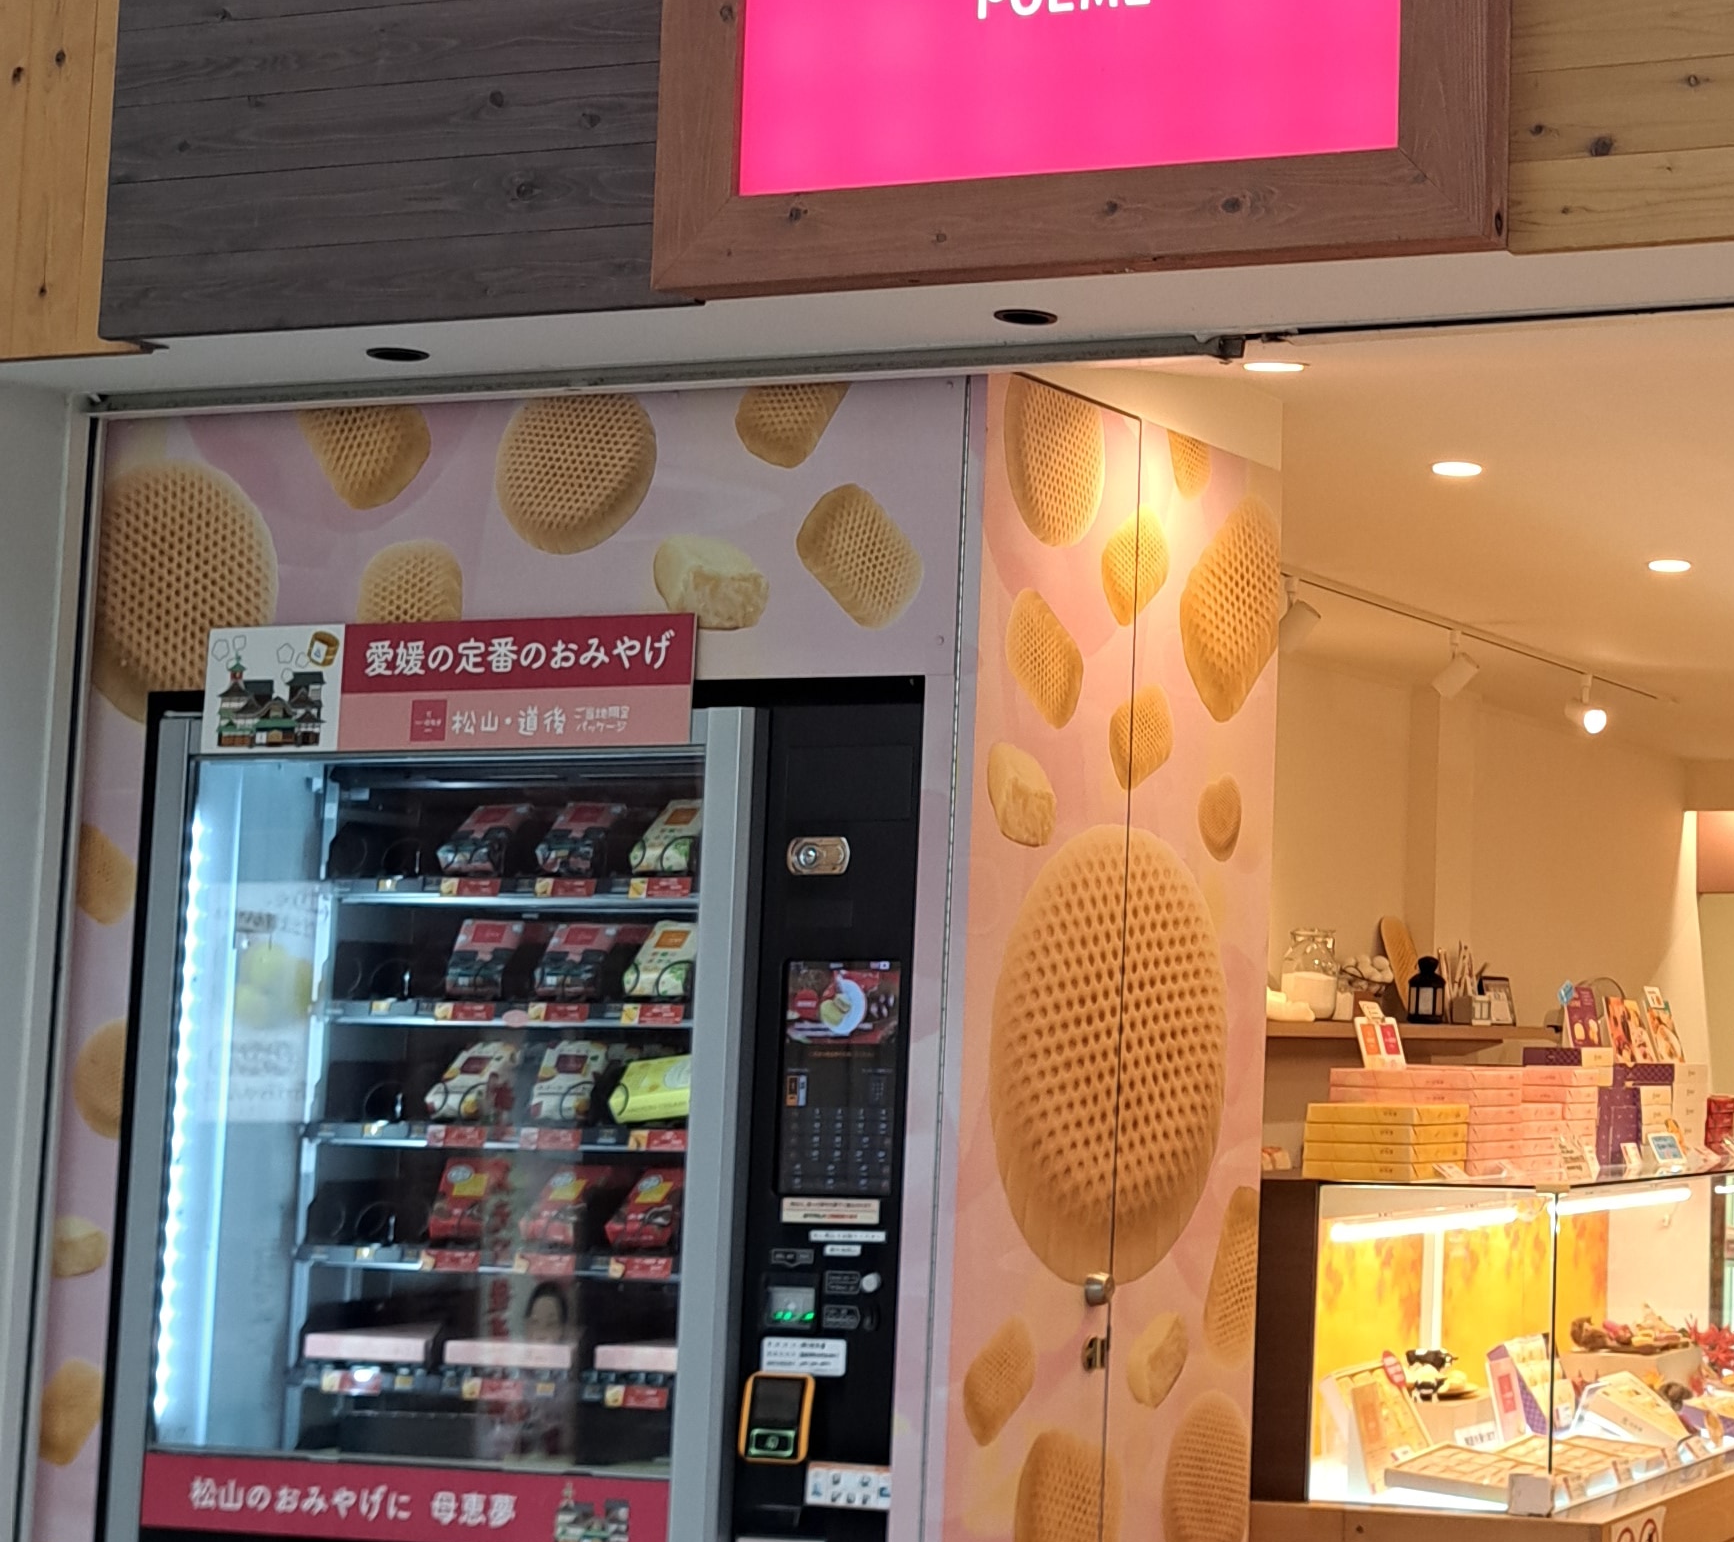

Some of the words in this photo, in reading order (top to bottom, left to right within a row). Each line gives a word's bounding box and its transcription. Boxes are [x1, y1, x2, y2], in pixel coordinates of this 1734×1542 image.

[364, 628, 676, 677] 愛媛の定番のおみやげ
[451, 704, 567, 736] 松山・道後
[188, 1476, 413, 1521] 松山のおみやげに
[430, 1490, 518, 1529] 母恵夢
